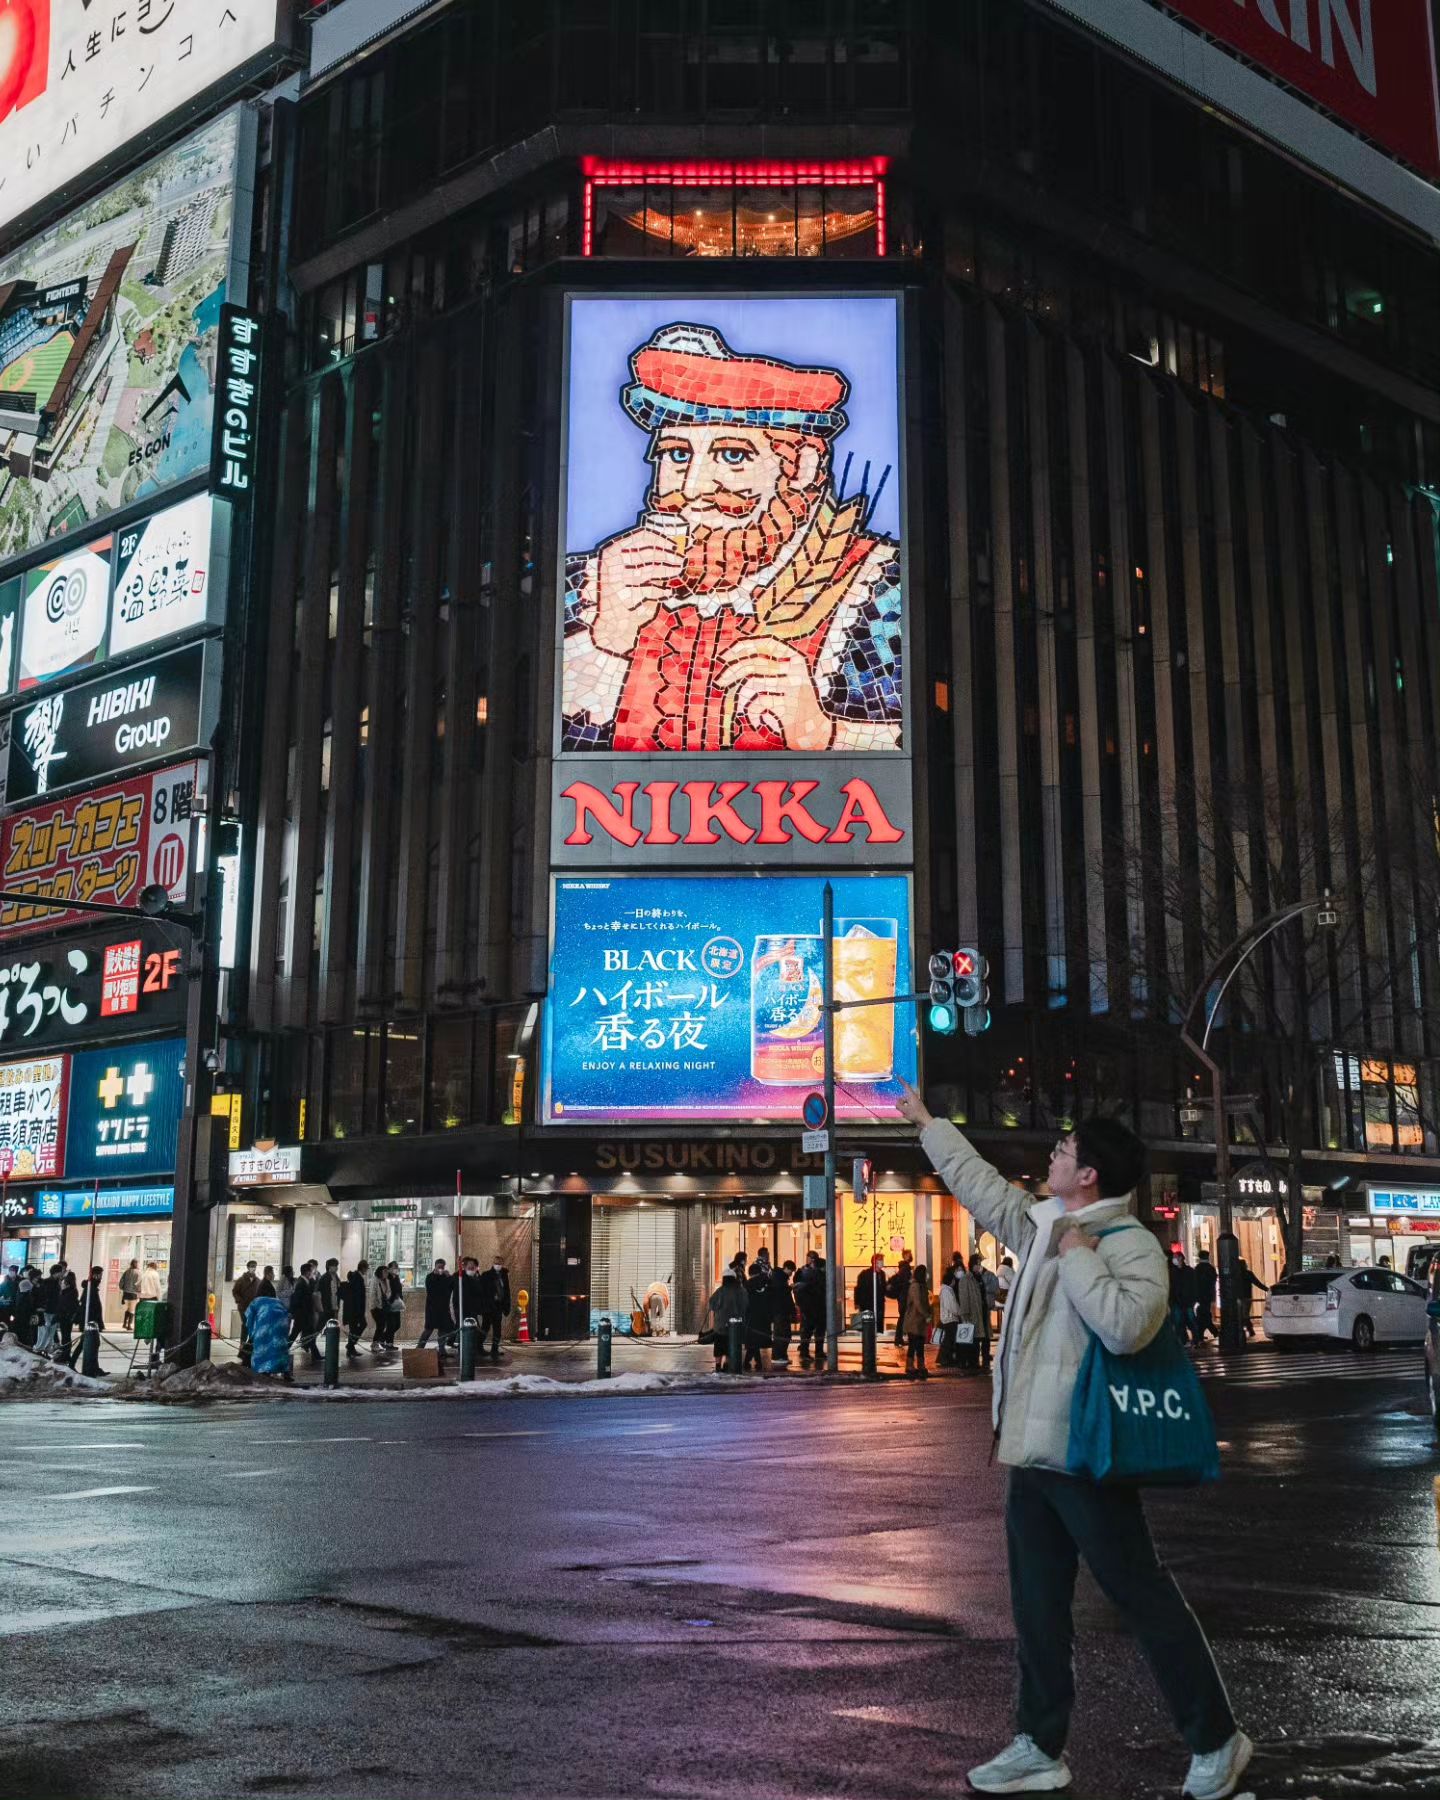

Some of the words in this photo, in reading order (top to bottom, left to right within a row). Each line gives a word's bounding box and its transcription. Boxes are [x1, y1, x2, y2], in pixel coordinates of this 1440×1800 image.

[121, 533, 138, 558] 2F
[87, 676, 156, 728] HIBIKI
[115, 716, 170, 753] Group
[560, 777, 905, 848] NIKKA
[4, 795, 143, 877] ネットカフェ
[623, 907, 688, 919] 一日の終わりを、
[143, 950, 182, 993] 2F
[603, 949, 698, 971] BLACK
[569, 979, 730, 1011] ハイボール
[590, 1011, 709, 1051] 香る夜
[582, 1062, 615, 1070] ENJOY
[619, 1062, 626, 1070] A
[629, 1062, 680, 1070] RELAXING
[684, 1062, 716, 1070] NIGHT
[98, 1116, 149, 1142] サツドラ
[596, 1142, 776, 1169] SUSUKINO
